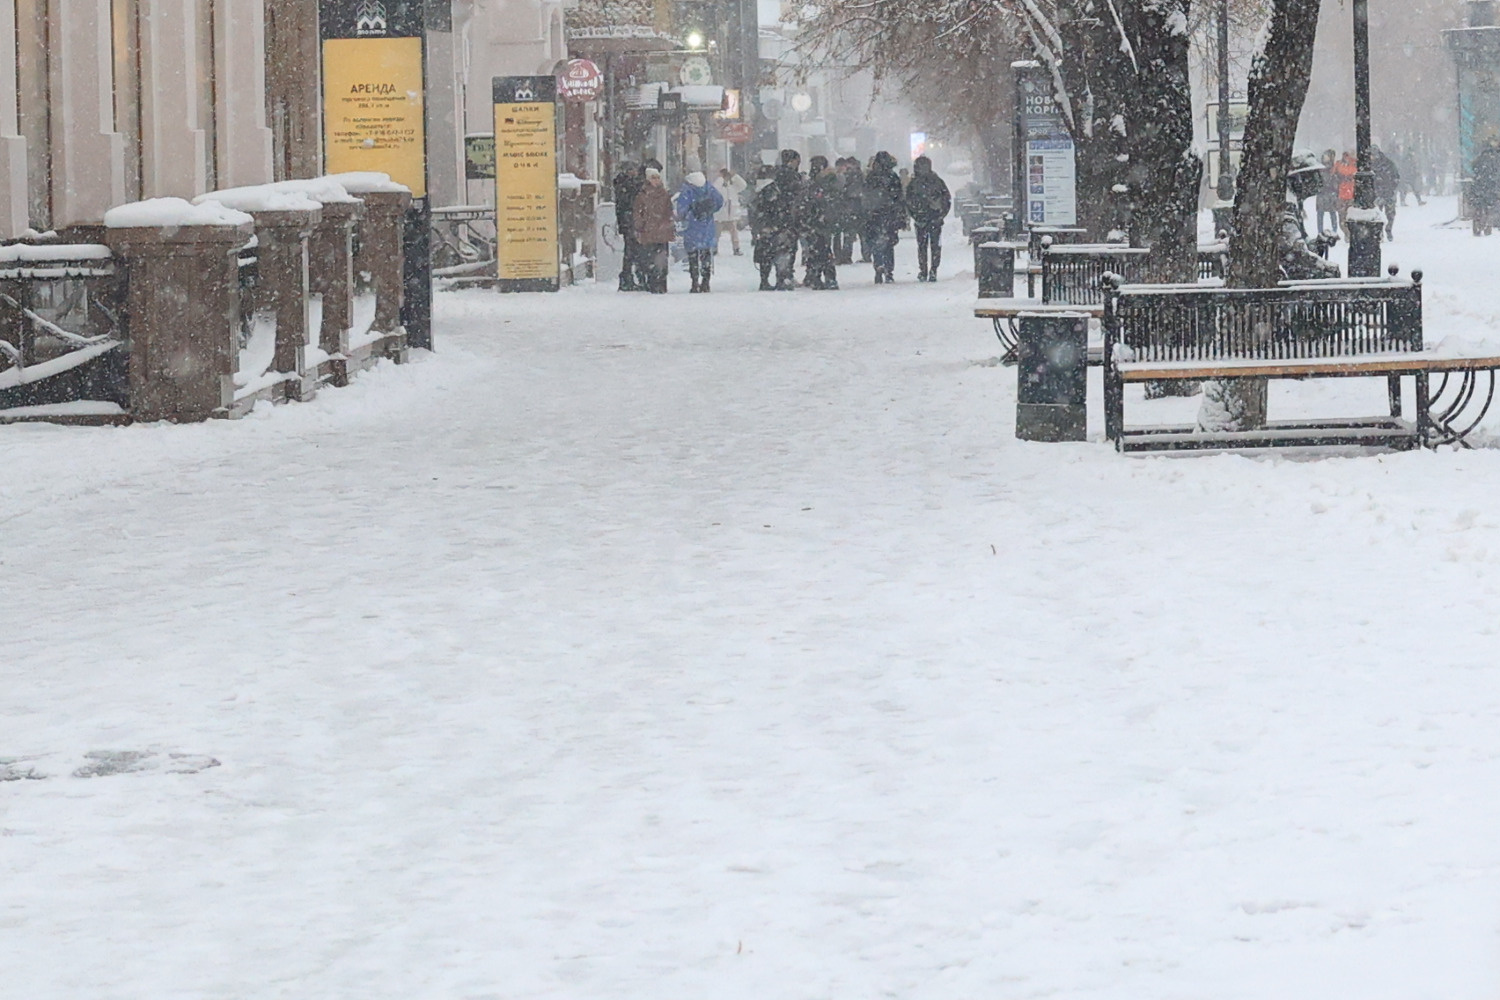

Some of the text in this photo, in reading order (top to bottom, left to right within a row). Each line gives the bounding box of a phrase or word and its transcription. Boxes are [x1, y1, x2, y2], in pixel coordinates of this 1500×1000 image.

[350, 83, 397, 95] АРЕНДА
[1026, 95, 1054, 105] НОВ
[1026, 105, 1059, 114] КОРП
